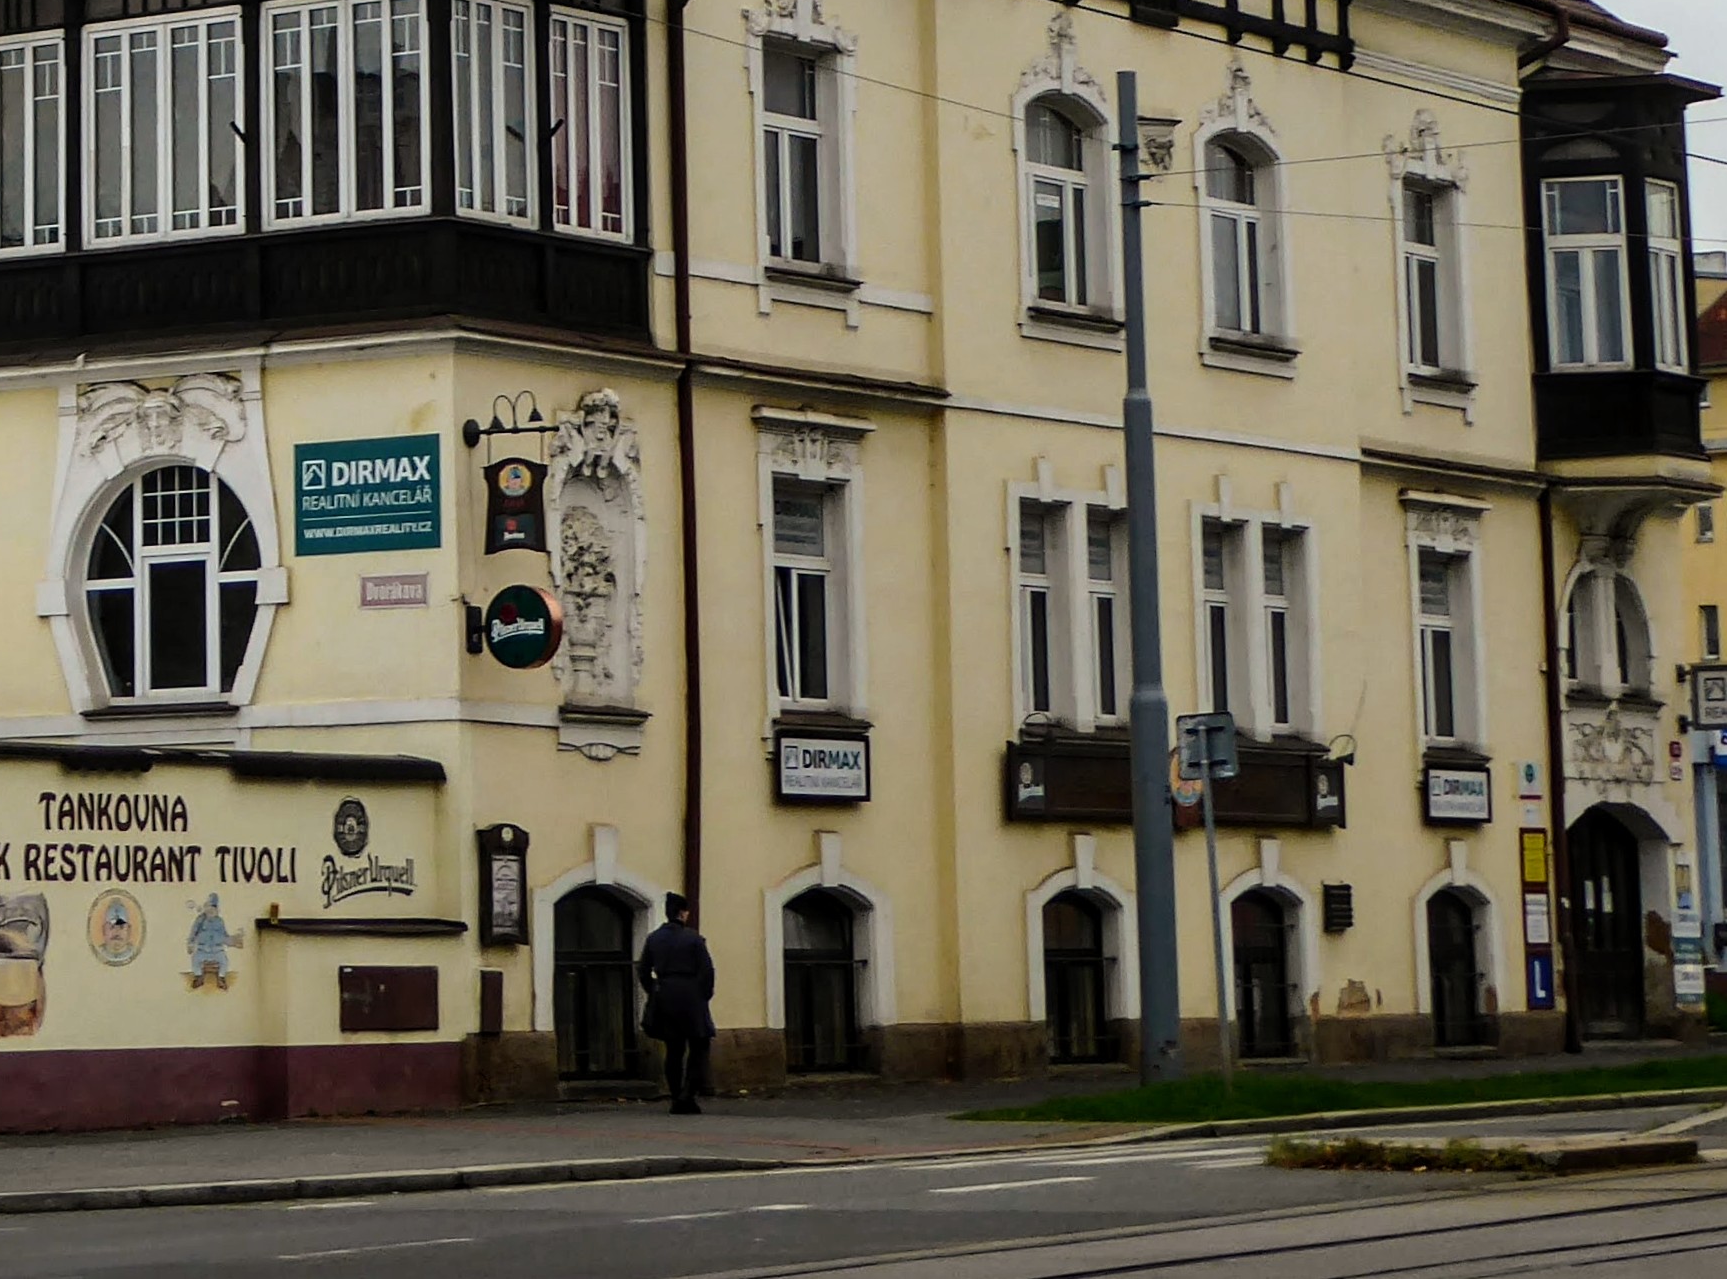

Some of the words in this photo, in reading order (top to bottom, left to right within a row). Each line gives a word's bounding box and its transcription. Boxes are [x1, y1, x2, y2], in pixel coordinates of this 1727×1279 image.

[331, 455, 431, 487] DIRMAX
[302, 489, 362, 511] REALITNÍ
[363, 484, 432, 507] KANCELÁŘ
[802, 749, 862, 770] DIRMAX
[38, 792, 188, 832] TANKOVNA
[24, 843, 202, 883] RESTAURANT
[215, 845, 297, 884] TIVOLI
[321, 855, 370, 909] Pilsner
